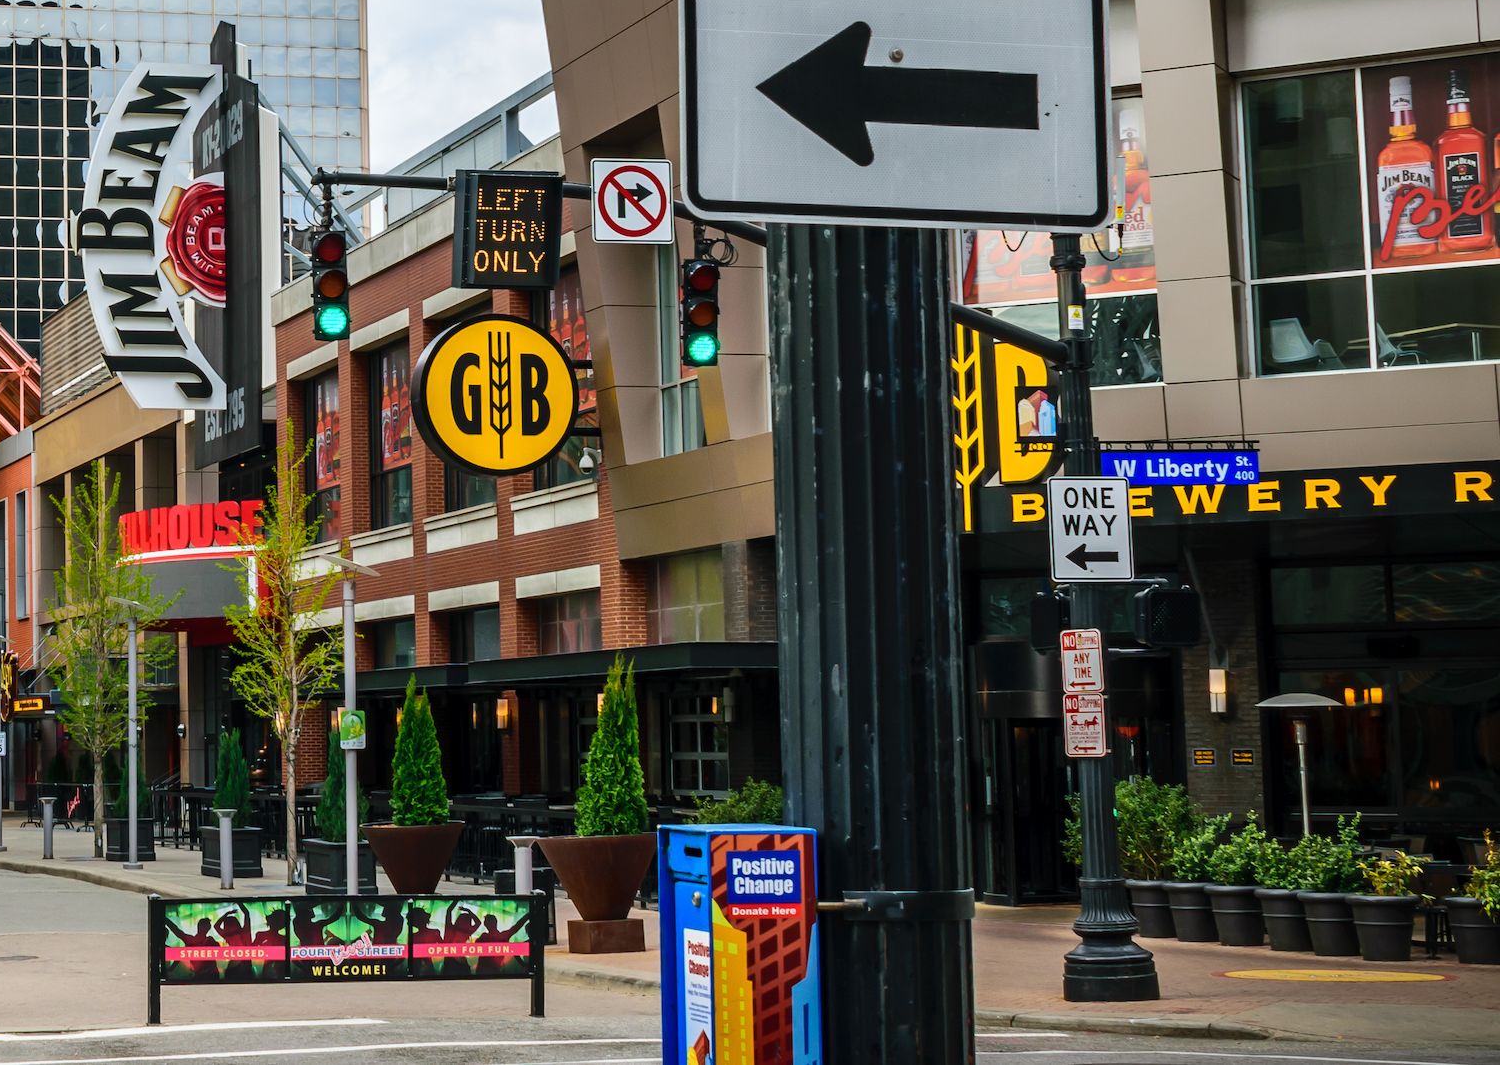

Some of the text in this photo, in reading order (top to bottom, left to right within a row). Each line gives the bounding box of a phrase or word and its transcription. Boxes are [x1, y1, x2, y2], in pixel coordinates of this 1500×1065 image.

[1382, 170, 1431, 192] JIM BEAM
[477, 187, 546, 212] LEFT
[75, 70, 216, 399] JIM BEAM
[186, 205, 214, 272] JIM BEAM
[476, 219, 546, 242] TURN
[473, 249, 546, 273] ONLY
[1106, 442, 1254, 450] DOWNTOWN
[1235, 456, 1253, 466] St.
[1113, 458, 1229, 482] W Liberty
[1235, 471, 1255, 480] 400
[1012, 475, 1397, 523] BEWERY
[1063, 487, 1115, 509] ONE
[1061, 514, 1118, 536] WAY
[1064, 635, 1075, 647] NO
[1074, 653, 1090, 664] ANY
[1074, 667, 1092, 678] TIME
[1066, 698, 1078, 710] NO
[732, 858, 795, 875] Positive
[734, 877, 793, 895] Change
[732, 906, 797, 916] Donate Here
[180, 948, 269, 958] STREET CLOSED.
[291, 948, 340, 958] FOURTH
[355, 945, 404, 956] STREET
[427, 944, 514, 954] OPEN FOR FUN.
[687, 940, 710, 957] Positive
[312, 964, 387, 976] WELCOME!
[689, 960, 709, 977] Change
